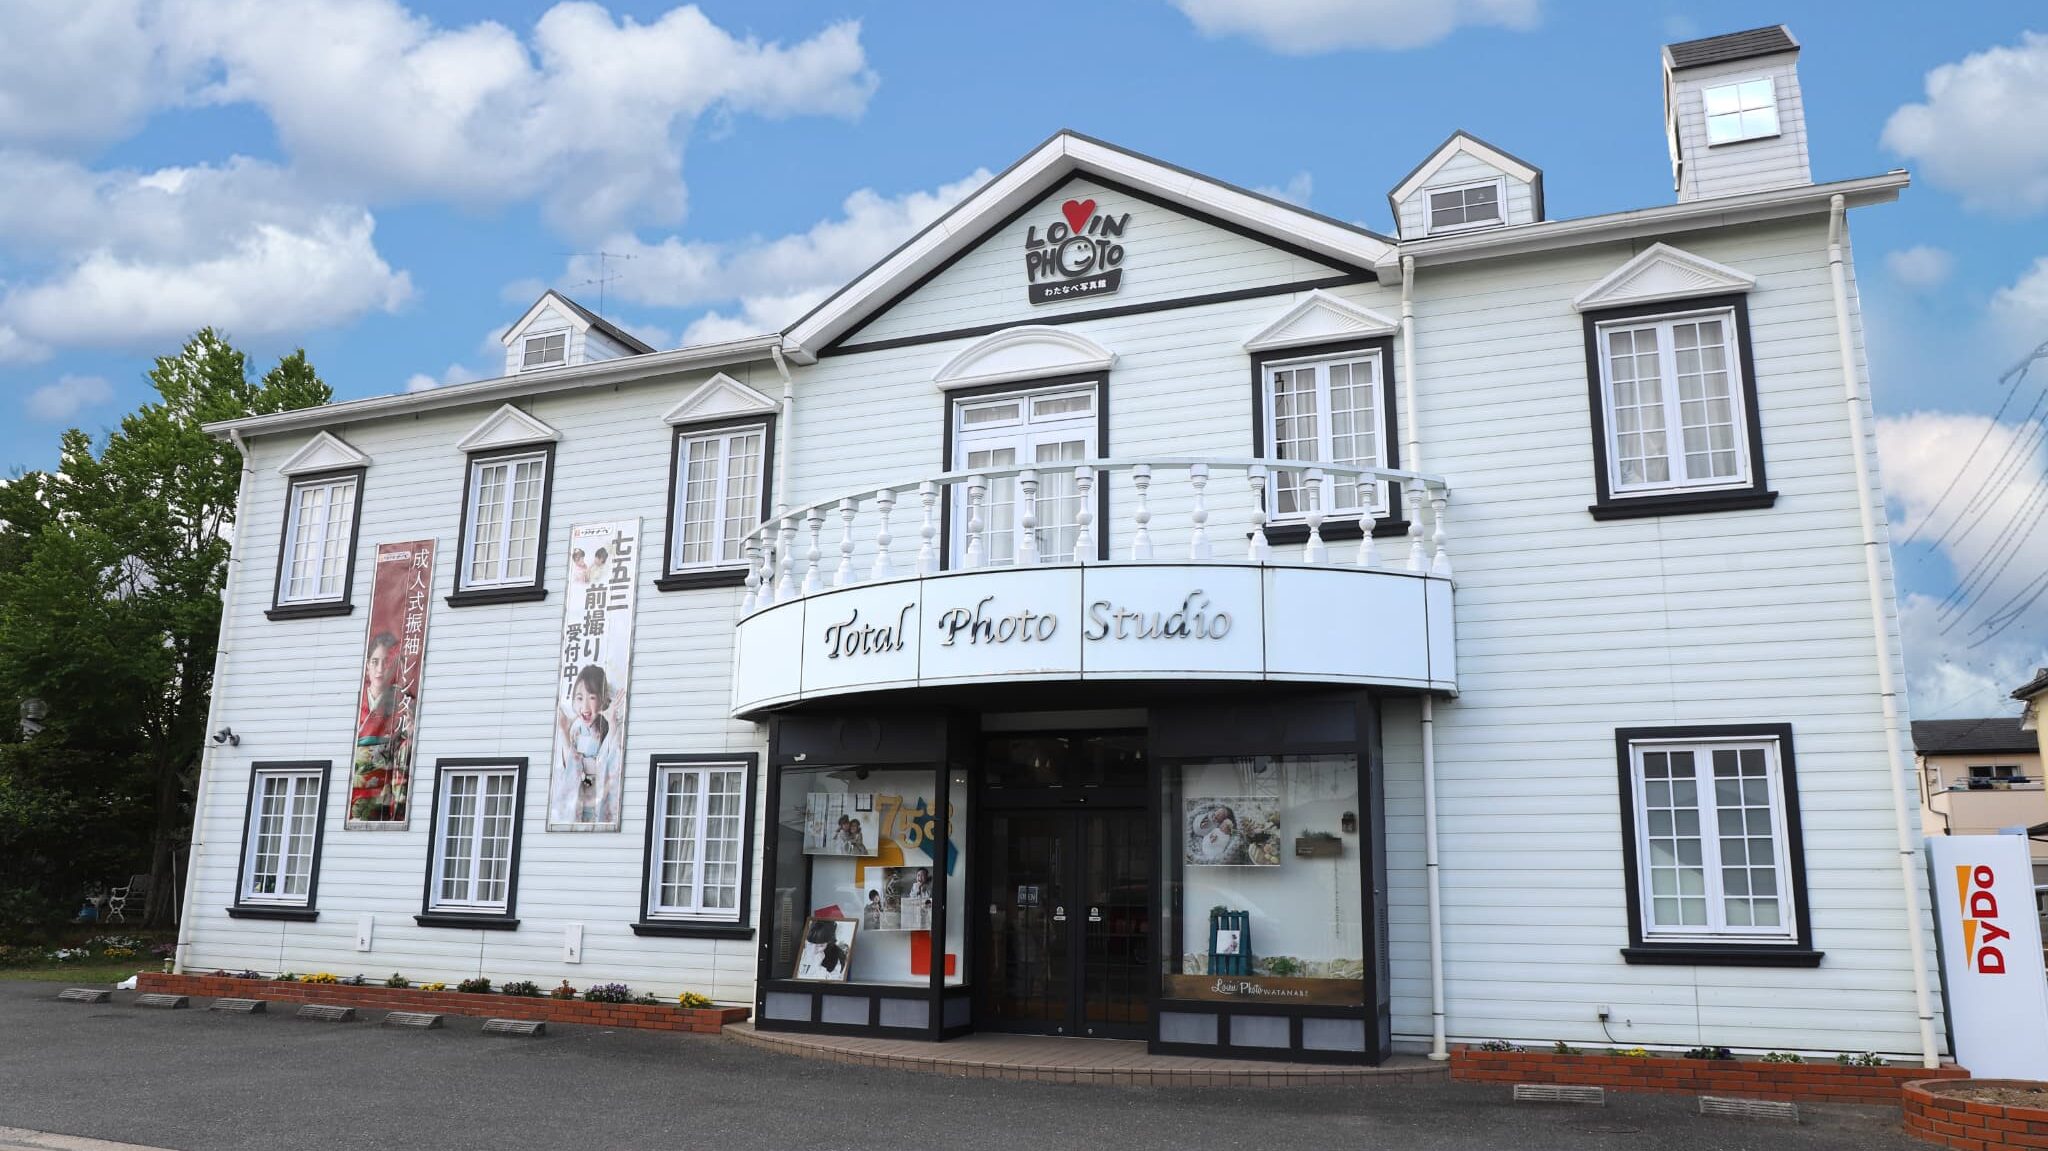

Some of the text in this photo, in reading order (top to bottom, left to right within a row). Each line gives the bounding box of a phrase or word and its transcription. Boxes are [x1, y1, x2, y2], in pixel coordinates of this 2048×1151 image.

[1025, 236, 1124, 282] PHOTO
[1045, 279, 1107, 296] わたなべ写真館
[607, 530, 634, 611] 七五三
[394, 548, 430, 732] 成人式振袖レンタル
[582, 584, 608, 662] 前撮り
[824, 589, 1233, 659] Total Photo Studio
[1970, 865, 2010, 974] DyDo
